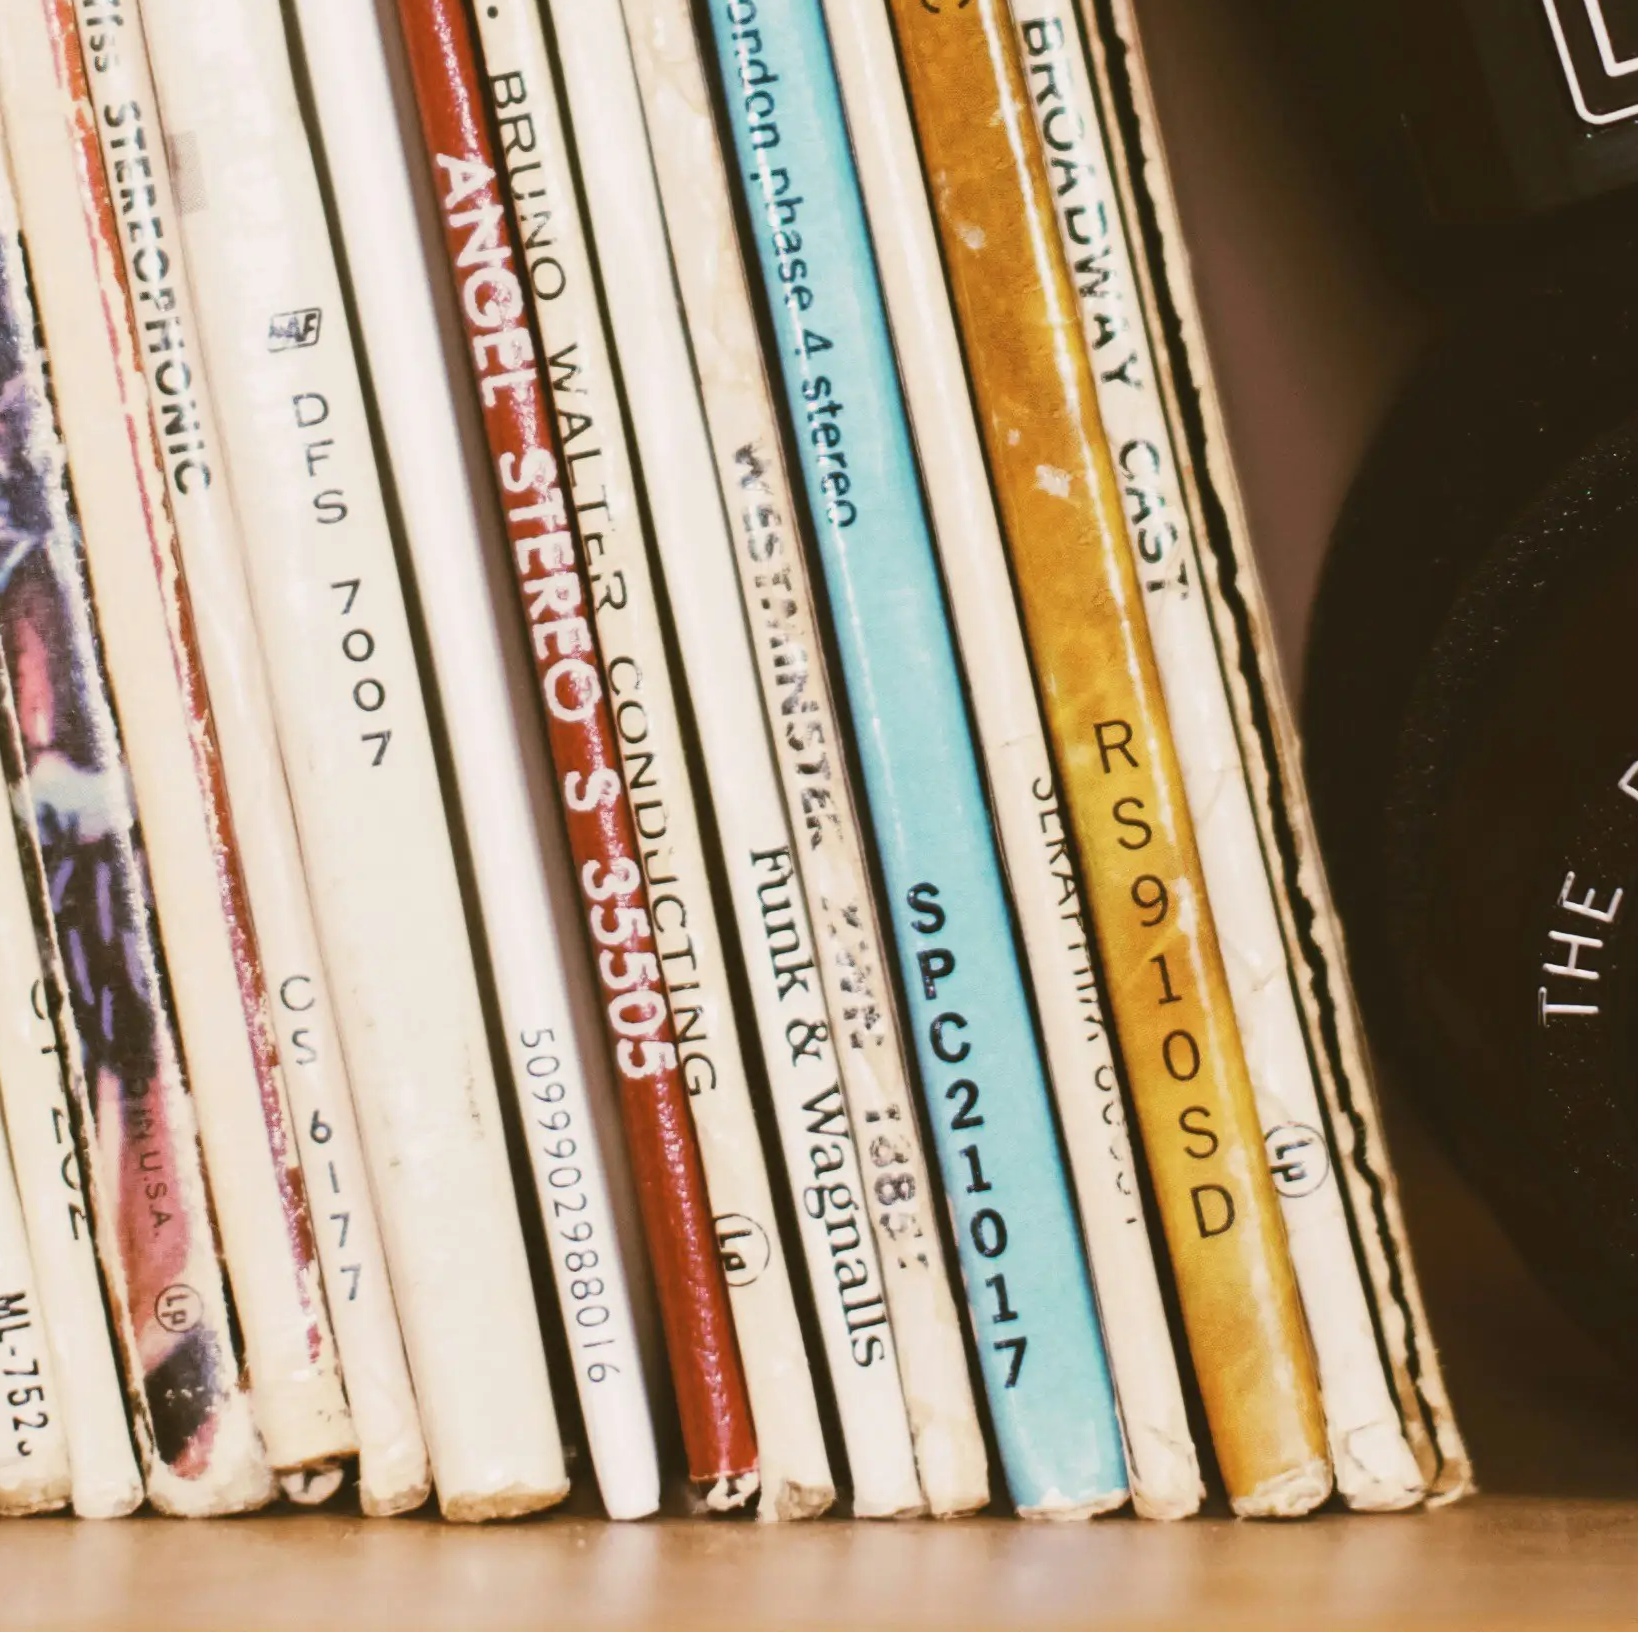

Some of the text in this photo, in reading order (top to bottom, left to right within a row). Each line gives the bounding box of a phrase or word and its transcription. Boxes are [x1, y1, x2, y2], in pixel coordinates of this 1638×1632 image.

[100, 99, 217, 498] STEREOPHONIC
[748, 167, 827, 312] phase
[1017, 17, 1144, 388] BROADWAY
[1113, 440, 1193, 600] CAST
[786, 328, 837, 359] 4
[795, 375, 868, 527] stereo
[327, 577, 399, 769] 7007
[432, 151, 681, 1080] ANGEL STEREO S 35505
[484, 70, 570, 302] BRUNO
[538, 343, 633, 612] WALTER
[596, 654, 725, 1098] CONDUCTING
[745, 845, 823, 1003] Funk
[1537, 871, 1623, 1027] THE
[782, 1017, 836, 1068] &
[515, 1029, 625, 1385] 5099902988016
[778, 1078, 899, 1369] Wagnalls
